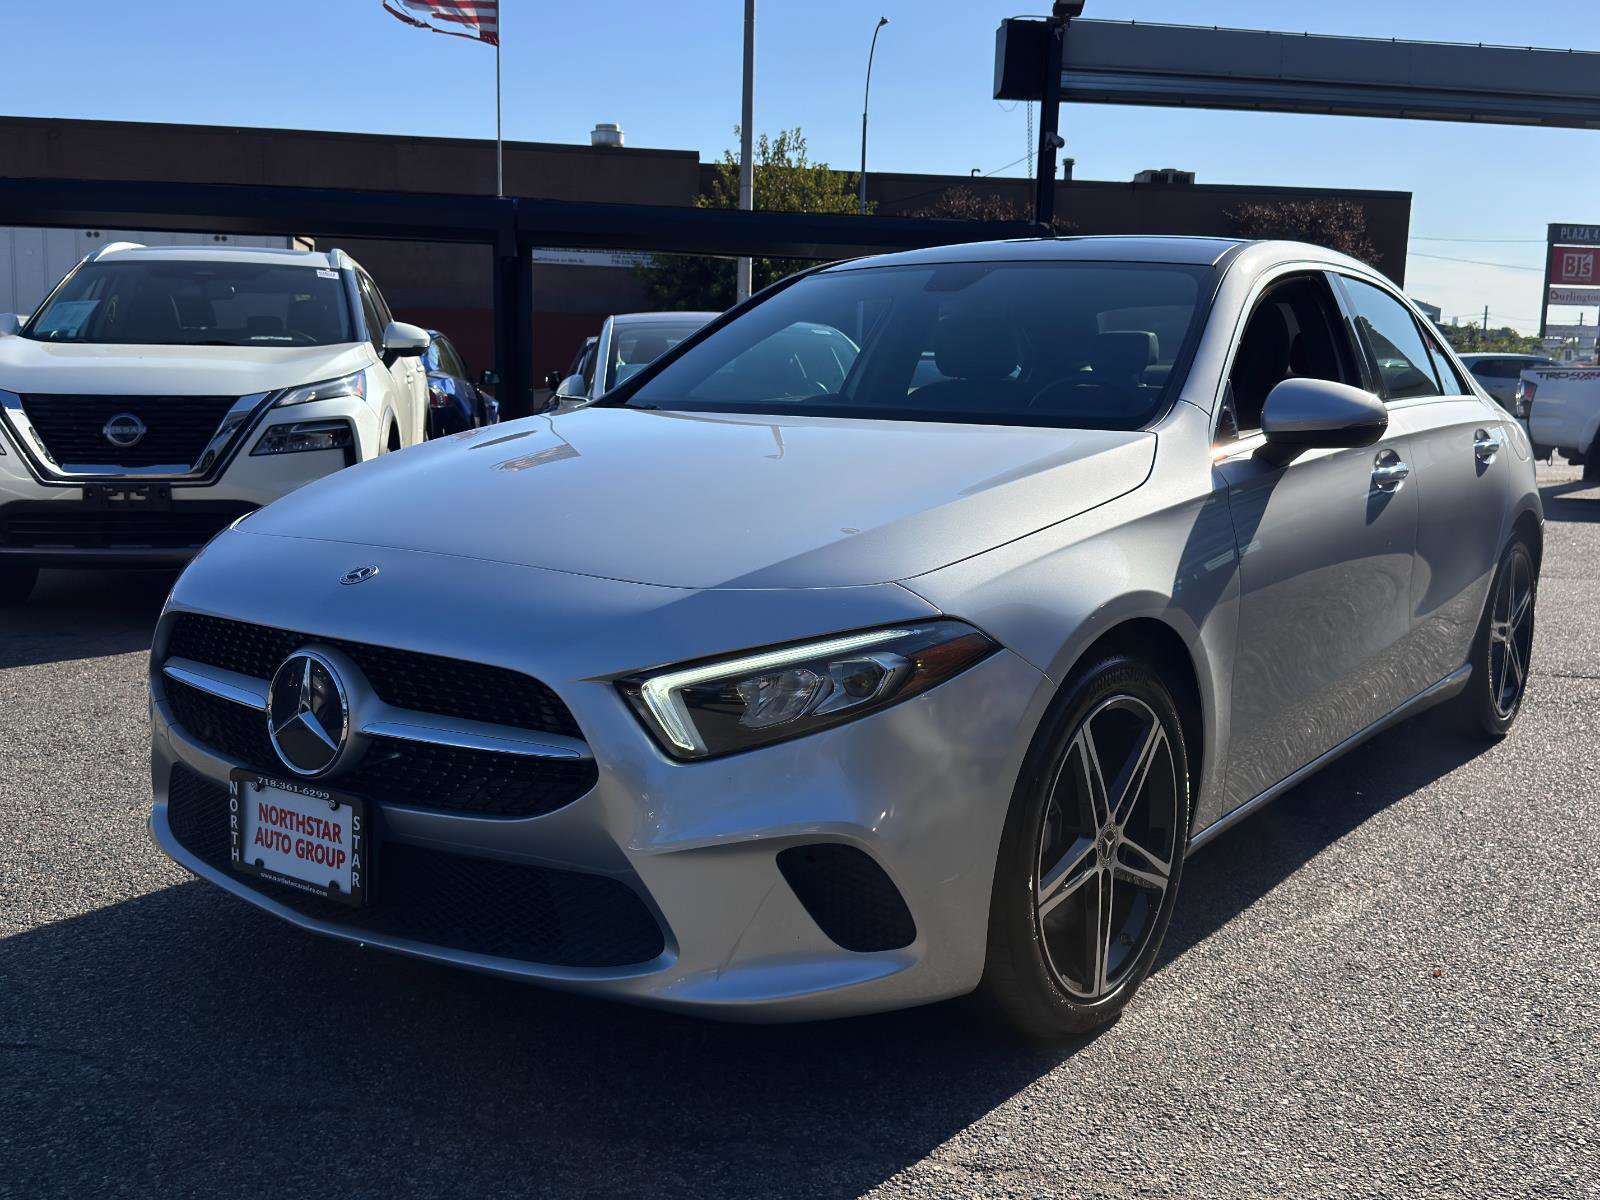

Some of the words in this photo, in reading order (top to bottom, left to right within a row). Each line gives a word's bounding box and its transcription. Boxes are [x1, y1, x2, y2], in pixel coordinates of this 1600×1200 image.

[1560, 226, 1590, 240] PLAZA
[1564, 254, 1592, 278] BJ's
[257, 776, 330, 800] 718-361-6299
[229, 780, 240, 862] NORTH
[258, 802, 342, 844] NORTHSTAR
[254, 826, 292, 855] AUTO
[295, 838, 346, 870] GROUP
[351, 816, 361, 888] STAR
